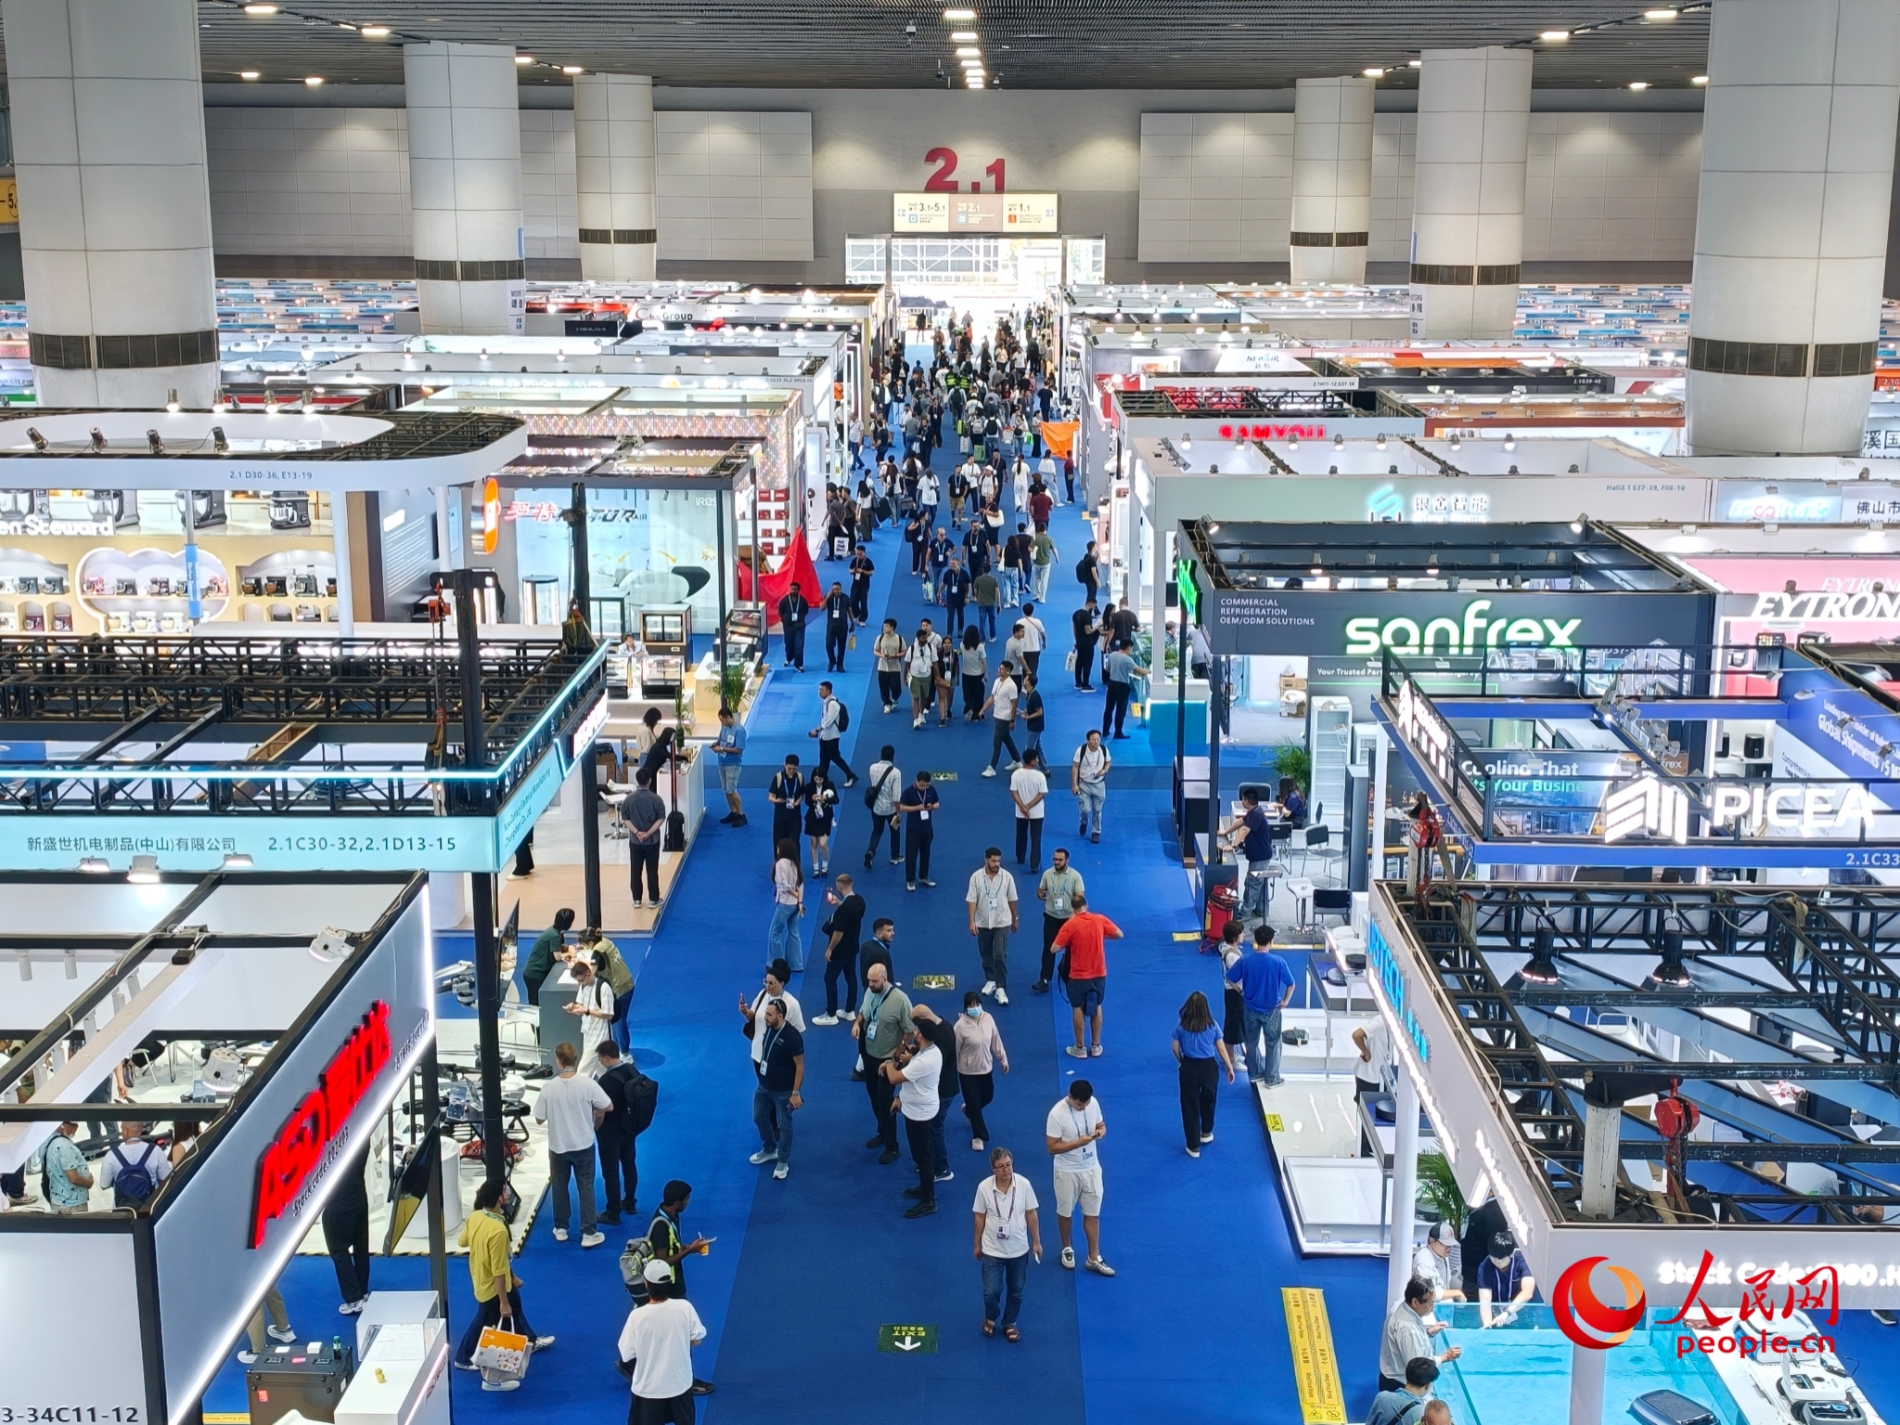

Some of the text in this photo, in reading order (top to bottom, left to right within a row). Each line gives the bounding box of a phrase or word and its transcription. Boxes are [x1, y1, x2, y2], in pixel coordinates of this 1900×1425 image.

[924, 147, 1005, 193] 2.1
[919, 203, 946, 212] 3.1-5.1
[968, 203, 981, 212] 2.1
[1019, 203, 1031, 212] 1.1
[230, 471, 242, 479] 2.1
[281, 471, 313, 479] E13-19
[25, 514, 115, 537] Steward
[1220, 598, 1279, 606] COMMERCIAL
[1220, 607, 1288, 616] REFRIGERATION
[1219, 616, 1264, 625] OEM/ODM
[1346, 600, 1582, 655] sanfrex
[1317, 668, 1335, 676] Your
[1336, 667, 1366, 676] Trusted
[1818, 713, 1841, 743] Global
[1841, 730, 1880, 769] Shipments
[1714, 786, 1876, 828] PICEA
[27, 837, 237, 853] 新盛世机电制品(中山)有限公司
[268, 836, 457, 851] 2.1C30-32,2.1D13-15
